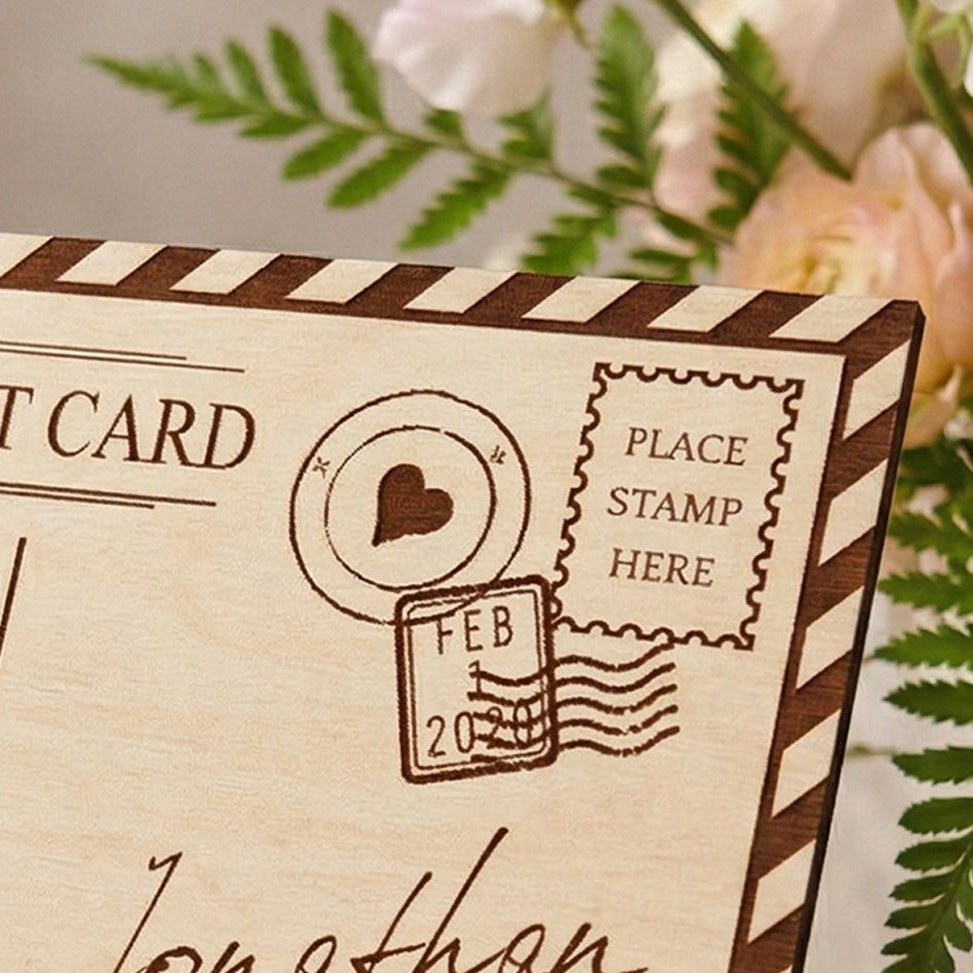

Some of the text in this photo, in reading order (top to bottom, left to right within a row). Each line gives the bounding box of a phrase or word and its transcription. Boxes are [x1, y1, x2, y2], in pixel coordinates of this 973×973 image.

[47, 389, 256, 470] CARD
[624, 426, 749, 466] PLACE
[606, 486, 743, 527] STAMP
[609, 547, 715, 587] HERE
[435, 605, 513, 655] FEB
[426, 699, 533, 758] 2020
